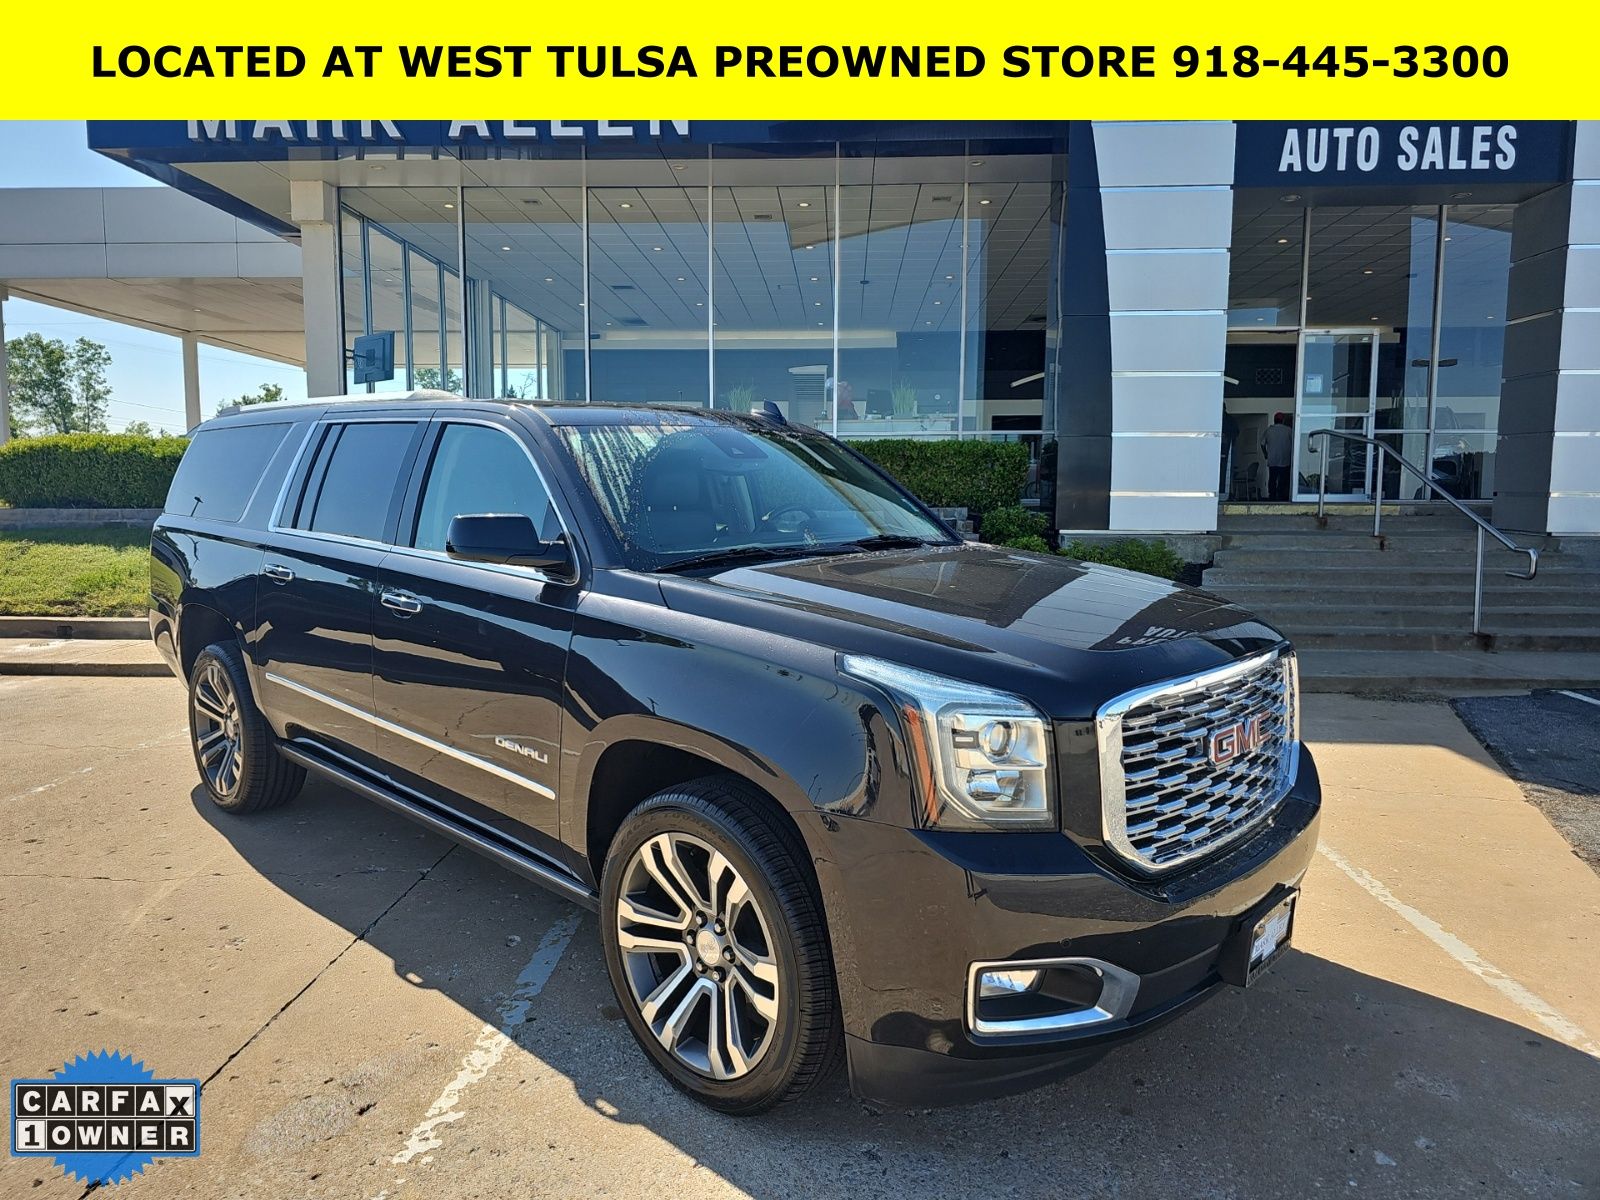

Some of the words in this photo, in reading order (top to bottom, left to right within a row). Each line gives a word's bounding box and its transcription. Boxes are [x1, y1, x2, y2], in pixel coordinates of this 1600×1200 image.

[1278, 126, 1380, 173] AUTO
[1397, 124, 1518, 172] SALES
[494, 735, 549, 764] DENALI
[1210, 711, 1272, 765] GMC
